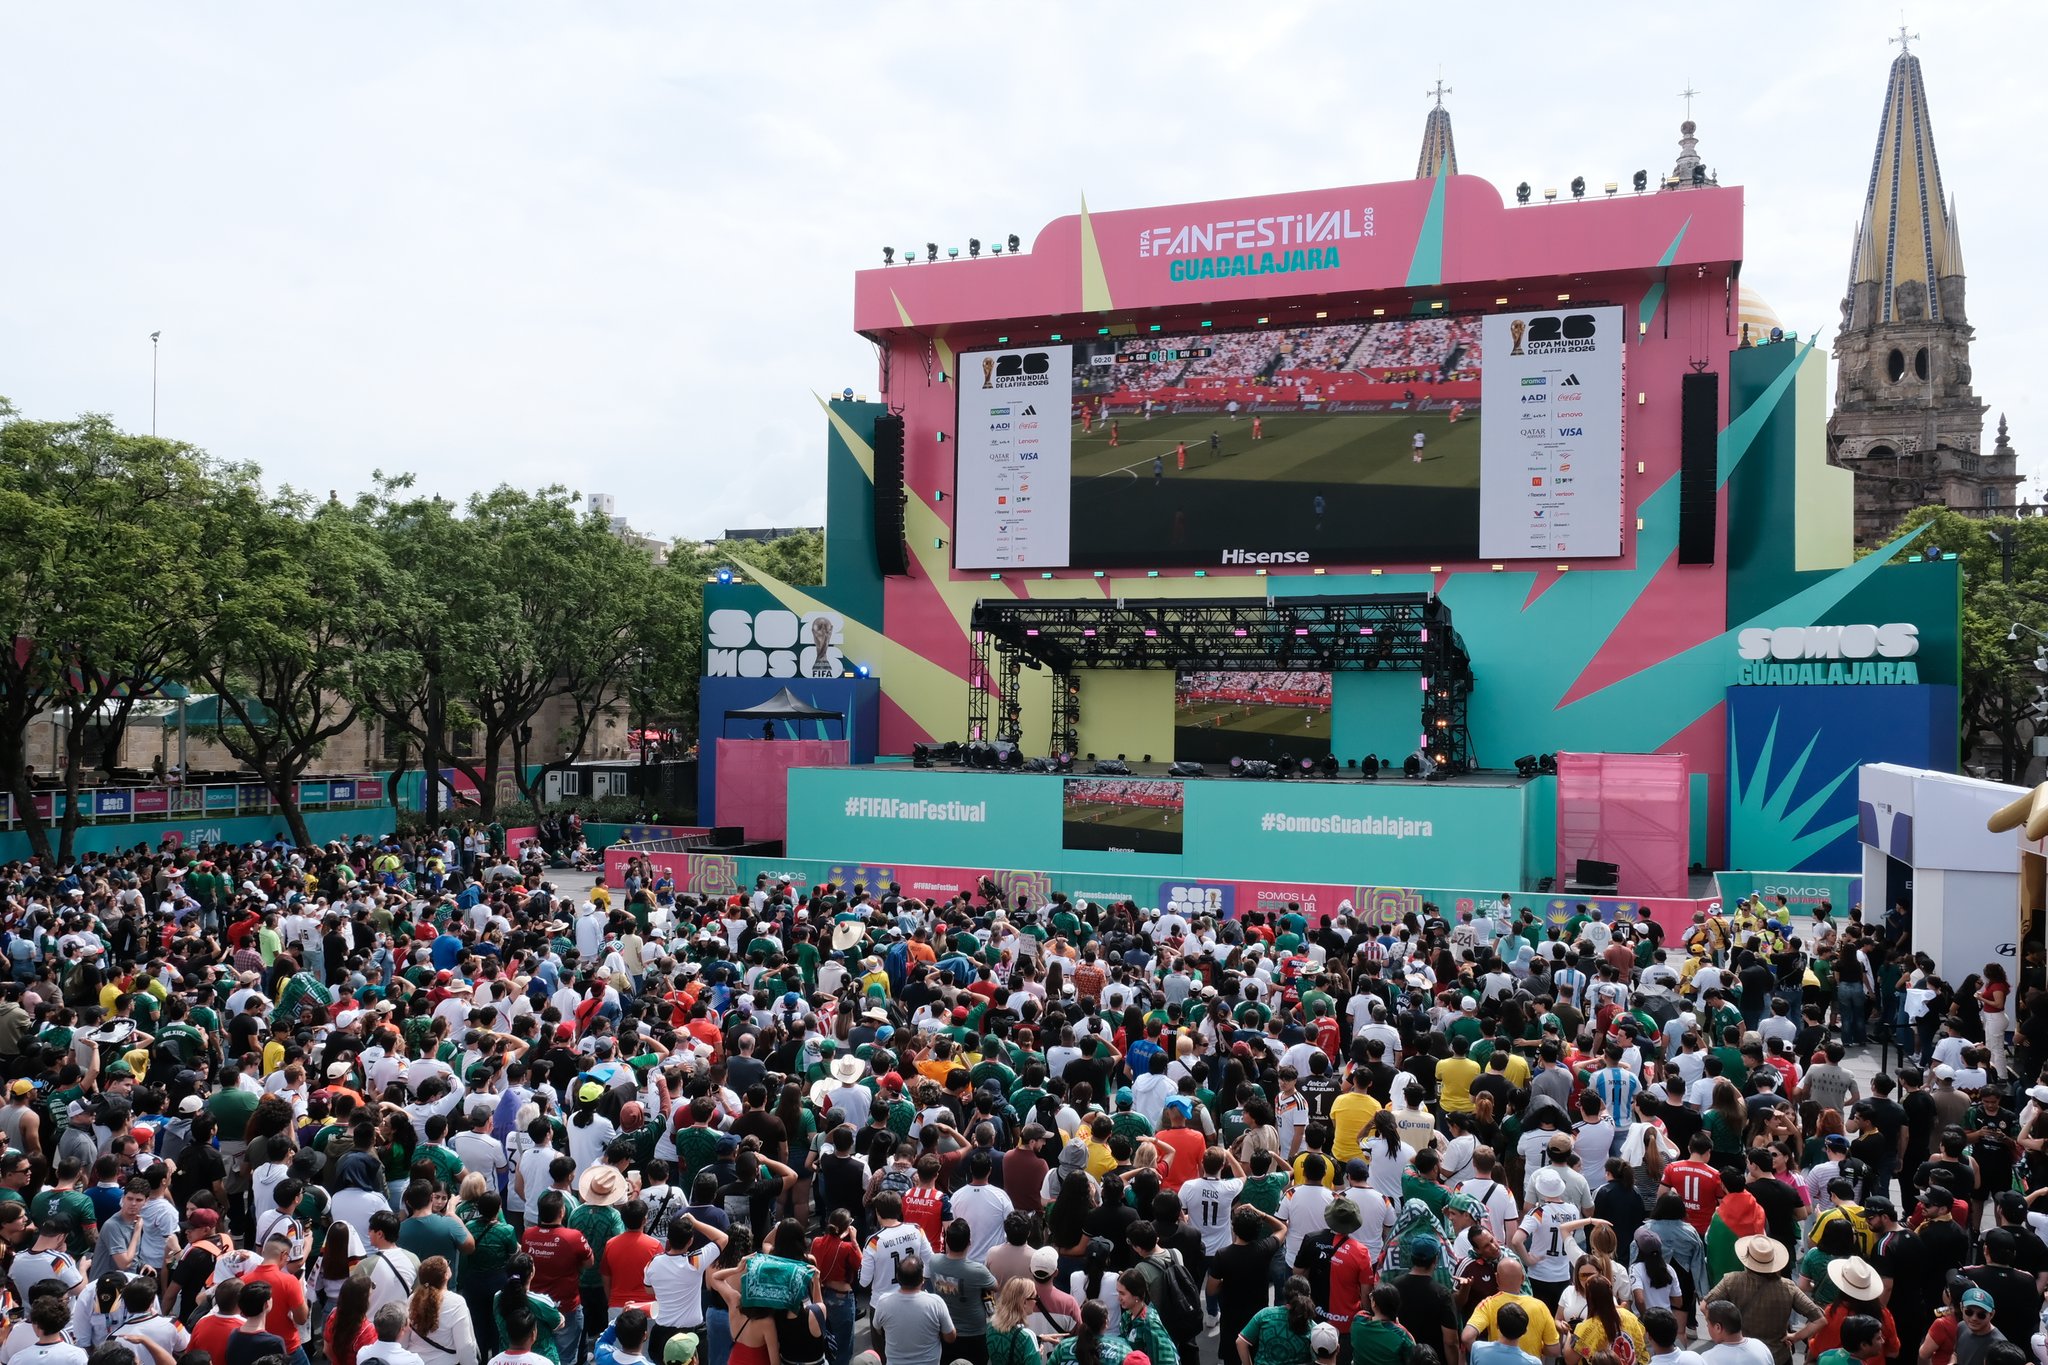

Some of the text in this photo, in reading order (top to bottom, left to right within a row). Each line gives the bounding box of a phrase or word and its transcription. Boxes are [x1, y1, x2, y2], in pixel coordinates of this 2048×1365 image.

[1363, 207, 1374, 236] 2026
[1140, 229, 1151, 257] FIFA
[1169, 246, 1341, 283] GUADALAJARA
[1528, 339, 1595, 349] COPA MUNDIAL
[1568, 345, 1596, 353] 2026
[1016, 374, 1049, 382] MUNDIAL
[1521, 377, 1546, 385] aramco
[1520, 428, 1546, 436] QATAR
[1559, 427, 1583, 437] VISA
[1019, 452, 1039, 461] VISA
[1221, 548, 1310, 565] Hisense
[1737, 622, 1920, 660] SOMOS
[812, 670, 833, 678] FIFA
[1736, 661, 1920, 686] GUADALAJARA
[845, 796, 986, 823] #FIFAFanFestival
[1261, 812, 1433, 839] #SomosGuadalajara
[195, 827, 221, 843] FAN
[1257, 891, 1317, 902] SOMOS LA
[1764, 885, 1831, 897] SOMOS
[1304, 902, 1317, 913] DEL
[1457, 932, 1472, 948] 24
[162, 1030, 187, 1038] MEXICO
[1313, 1093, 1323, 1116] 1
[1399, 1119, 1430, 1131] Corona
[1202, 1188, 1219, 1200] REUS
[1684, 1175, 1699, 1202] 11
[905, 1196, 934, 1208] OMNILIFE
[1201, 1200, 1219, 1227] 11
[525, 1238, 558, 1248] Seguros Atlas
[535, 1248, 555, 1257] Dalton
